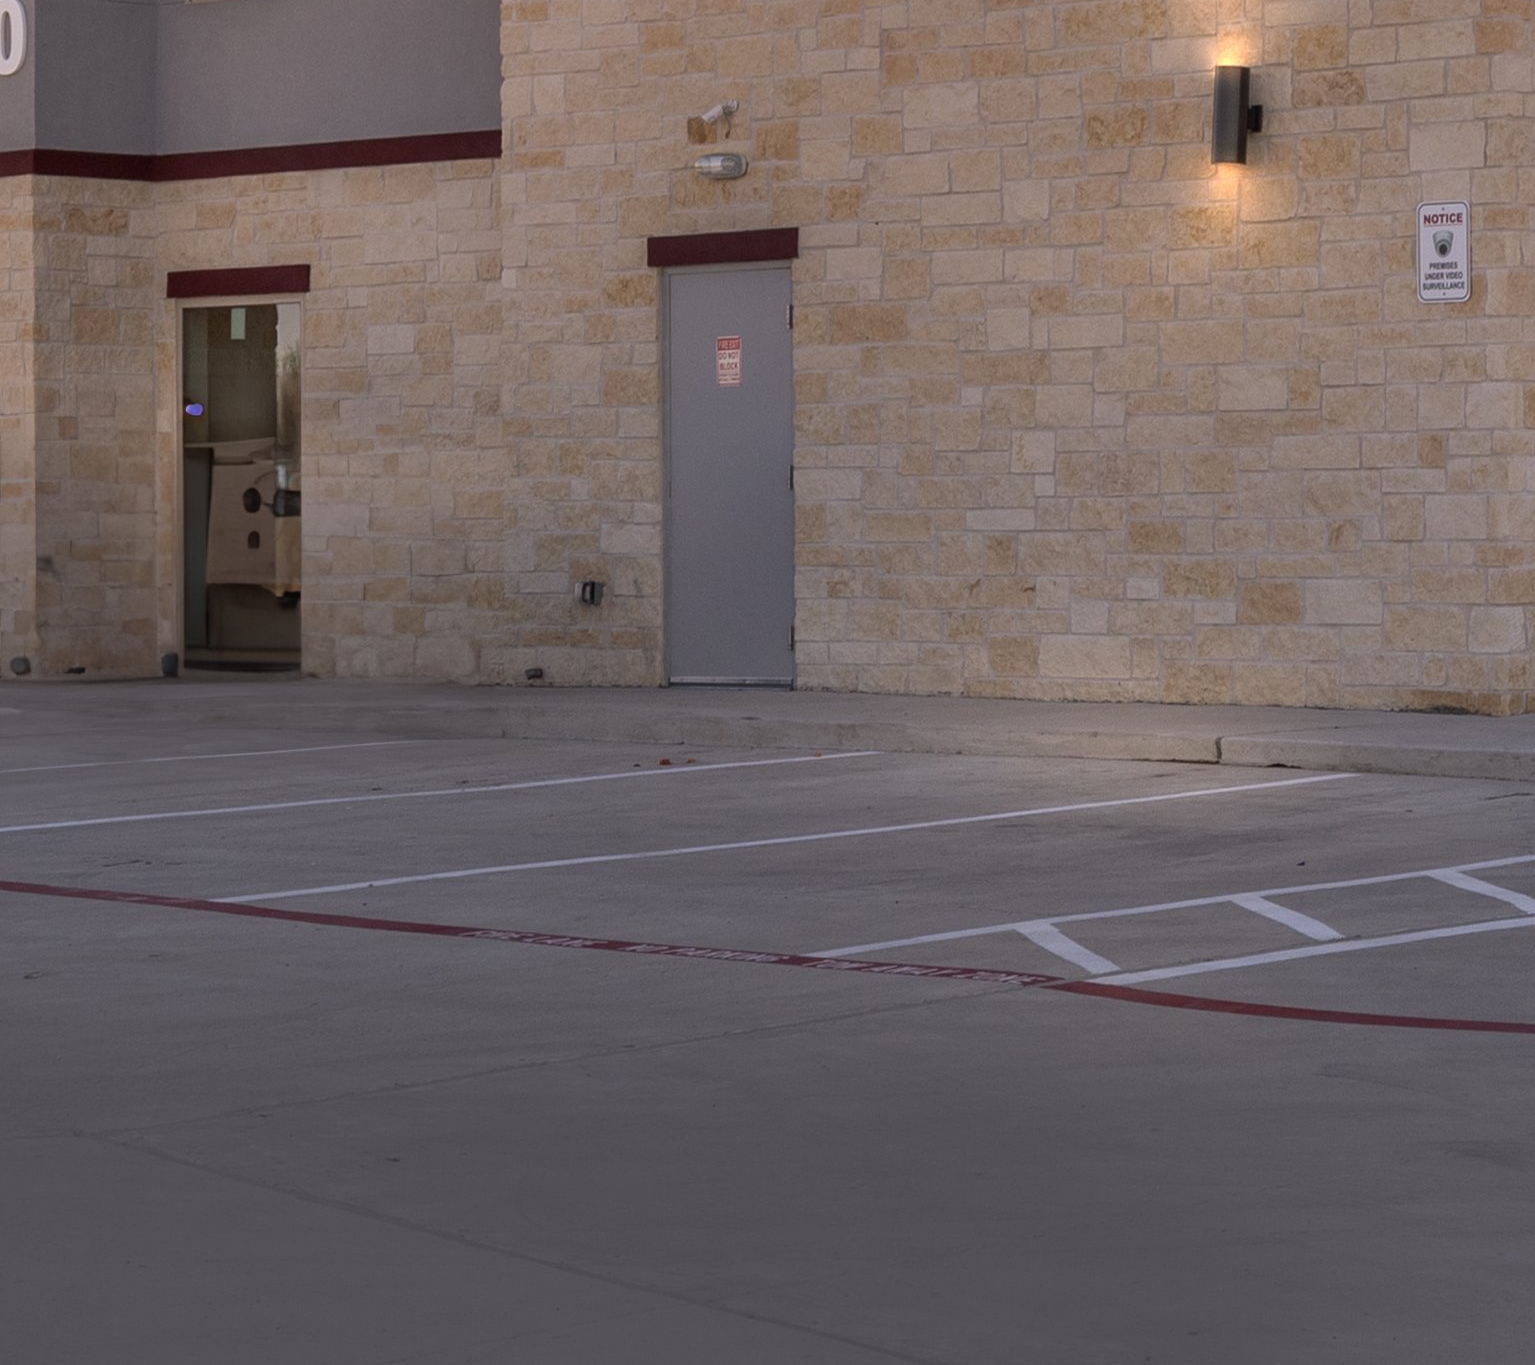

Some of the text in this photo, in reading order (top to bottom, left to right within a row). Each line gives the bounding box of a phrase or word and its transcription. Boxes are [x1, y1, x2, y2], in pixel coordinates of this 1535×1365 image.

[1423, 212, 1463, 225] NOTICE
[1429, 261, 1458, 270] PREMISES
[1424, 271, 1463, 280] UNDER VIDEO
[1422, 281, 1465, 291] SURVEILLANCE
[524, 936, 608, 947] LANE
[618, 945, 670, 953] NO
[659, 948, 791, 962] PARKING
[861, 965, 965, 976] AWAY
